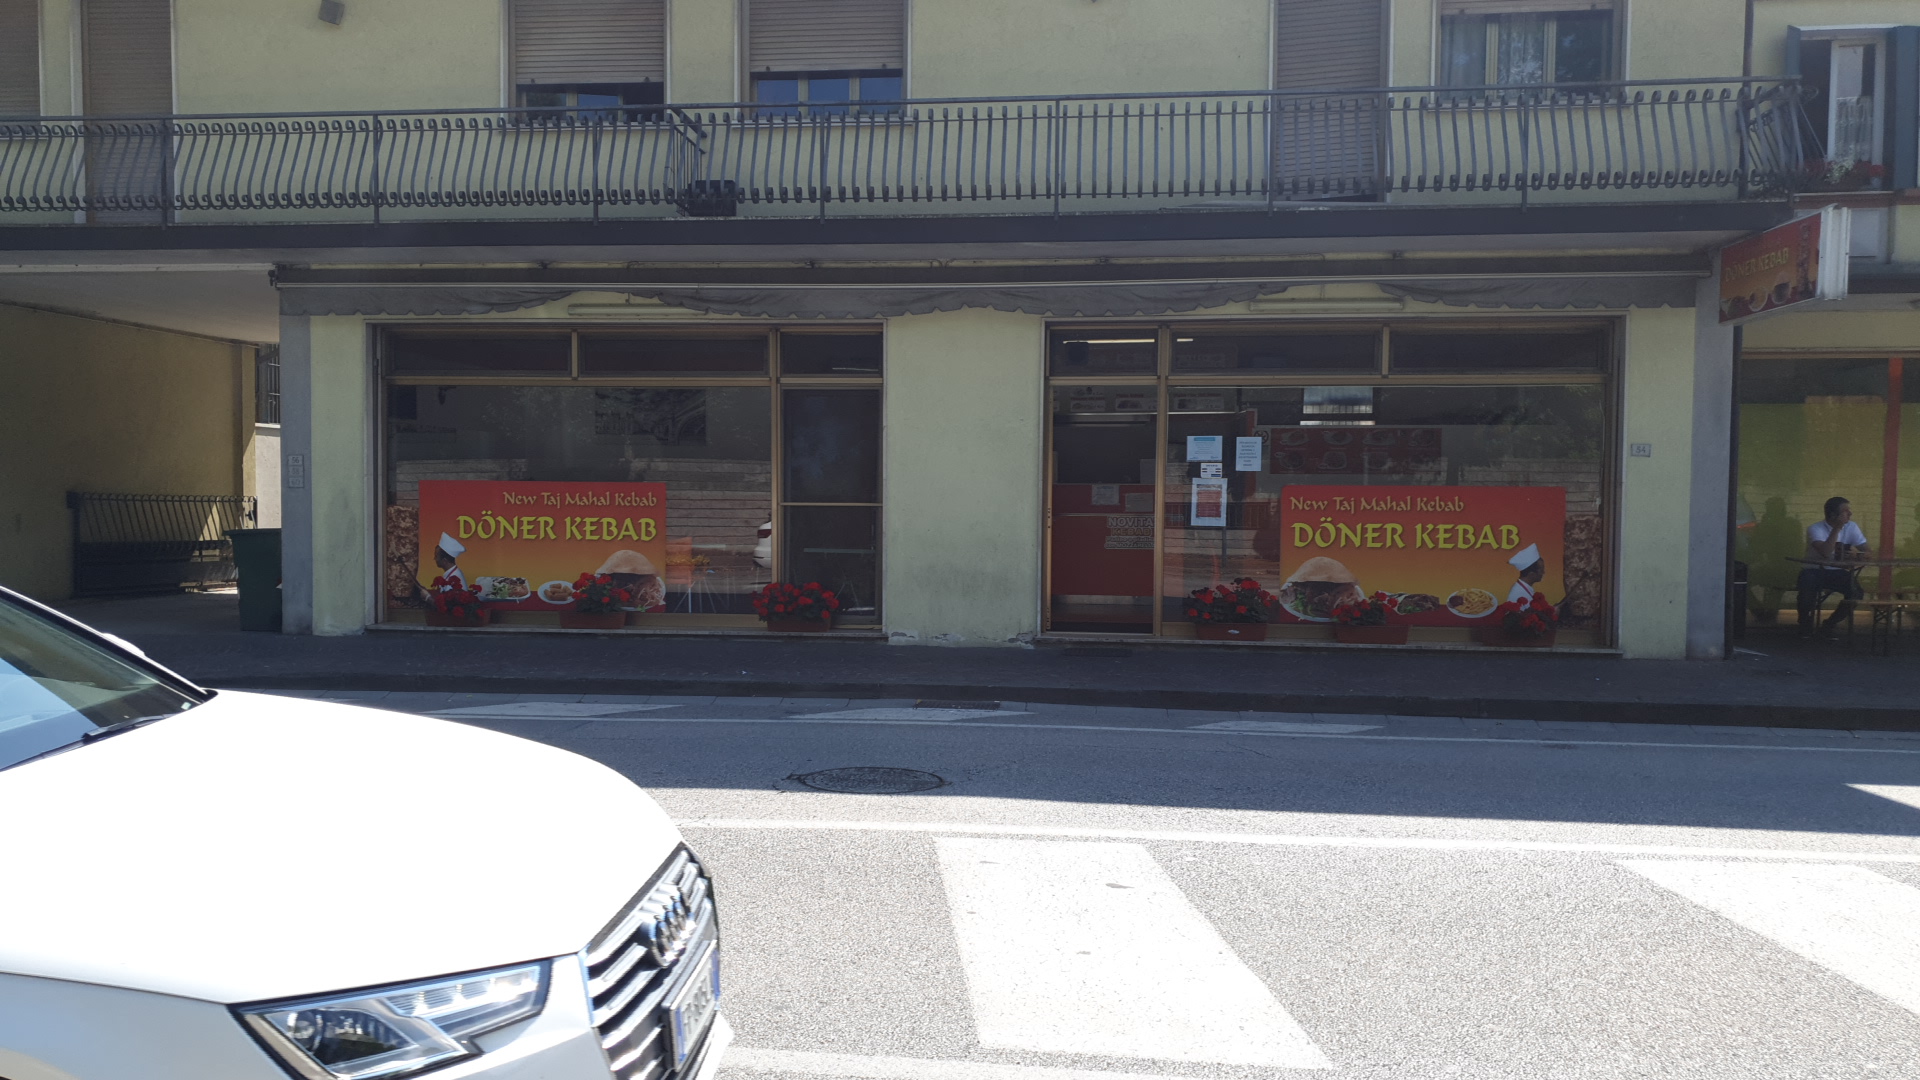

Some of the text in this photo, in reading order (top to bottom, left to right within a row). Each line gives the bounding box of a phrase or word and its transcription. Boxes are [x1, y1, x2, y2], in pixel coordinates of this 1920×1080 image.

[1758, 247, 1789, 271] KEBAB
[1635, 445, 1646, 453] 54
[503, 491, 657, 509] New Taj Mahal Kebab
[1289, 496, 1464, 514] New Taj Mahal Kebab
[456, 510, 657, 542] DÖNER KEBAB
[1112, 527, 1151, 536] KEBAB
[1290, 516, 1520, 550] DÖNER KEBAB
